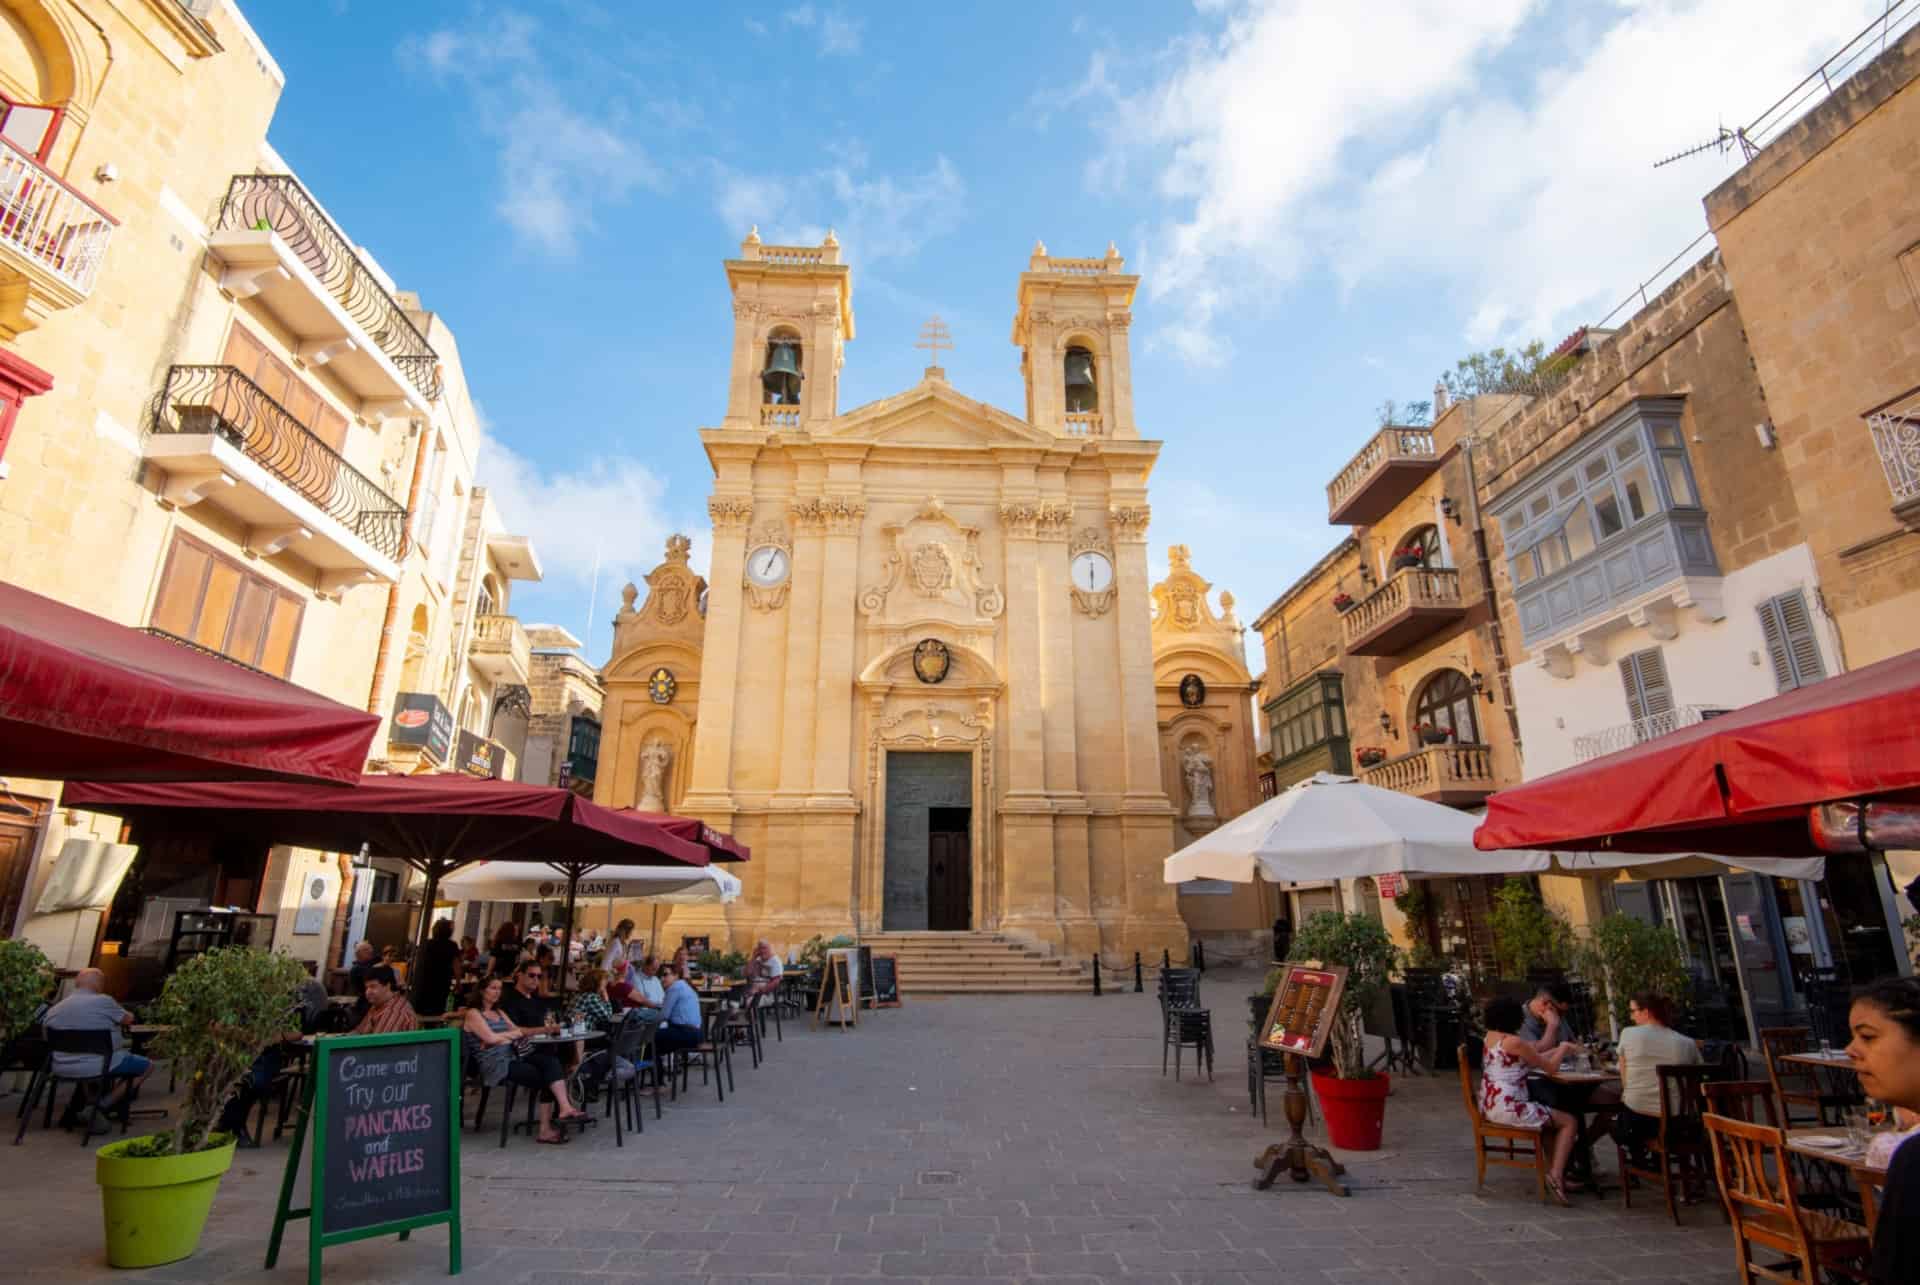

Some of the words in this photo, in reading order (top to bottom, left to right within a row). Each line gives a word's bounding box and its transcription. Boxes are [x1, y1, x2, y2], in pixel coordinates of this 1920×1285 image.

[339, 1056, 387, 1082] Come
[395, 1052, 418, 1075] and
[346, 1083, 374, 1110] Try
[382, 1081, 414, 1103] our
[344, 1104, 432, 1142] PANCAKES
[365, 1134, 391, 1154] and
[349, 1148, 425, 1183] WAFFLES
